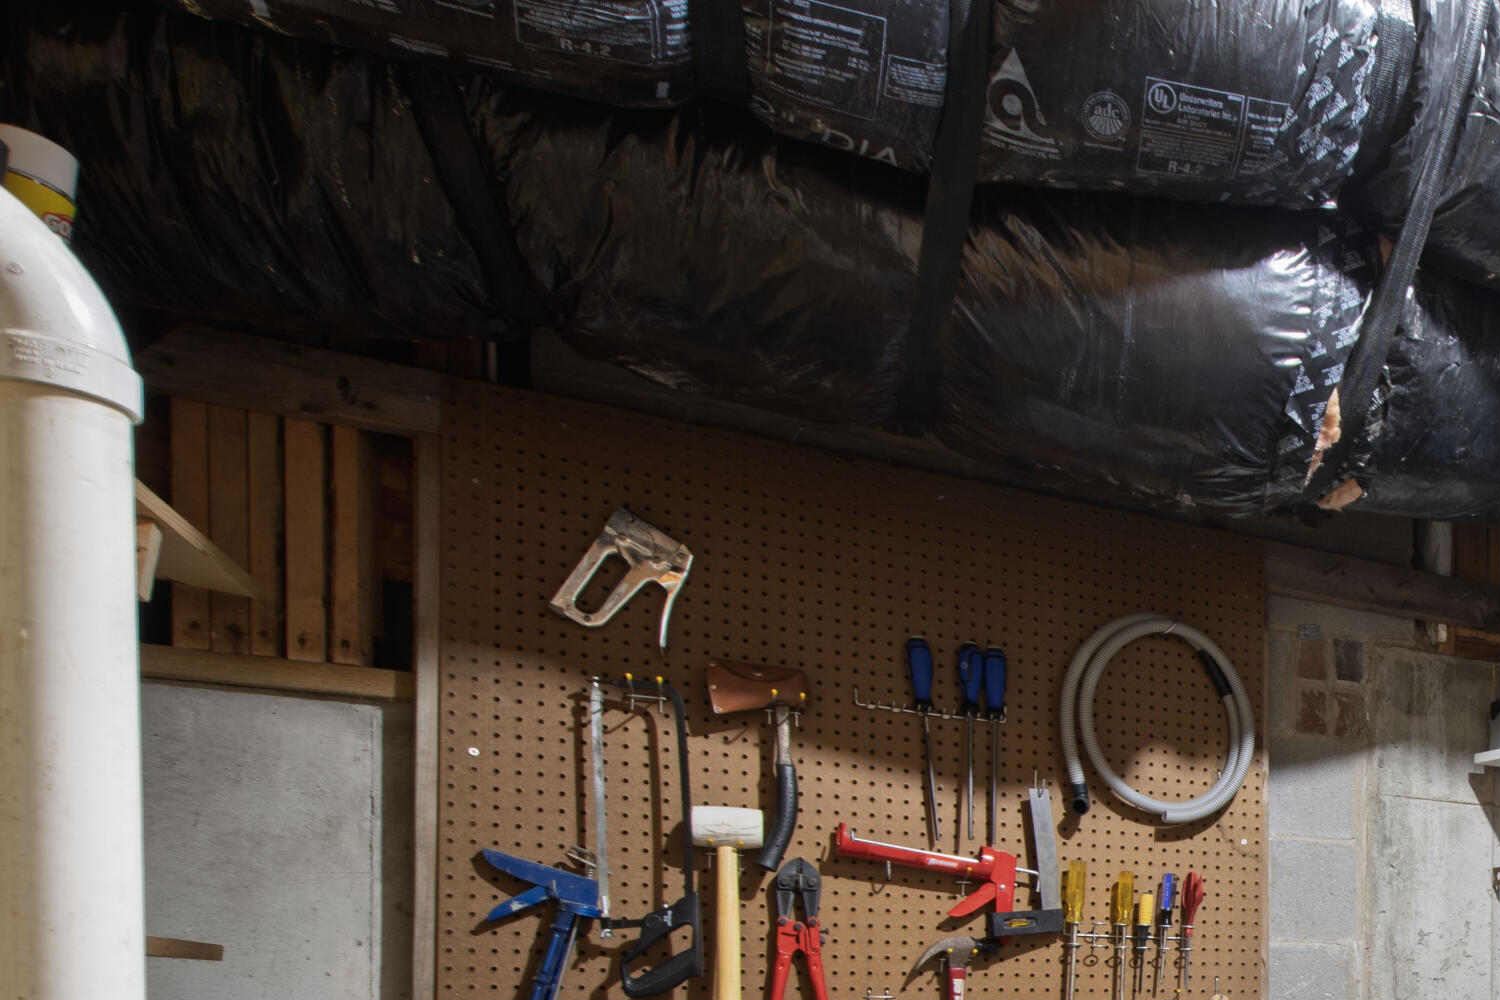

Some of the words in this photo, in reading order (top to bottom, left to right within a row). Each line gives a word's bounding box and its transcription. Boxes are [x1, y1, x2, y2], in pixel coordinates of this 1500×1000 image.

[560, 38, 612, 57] R-4.2
[1179, 91, 1224, 109] Underwriters
[1178, 103, 1219, 117] Laboratories
